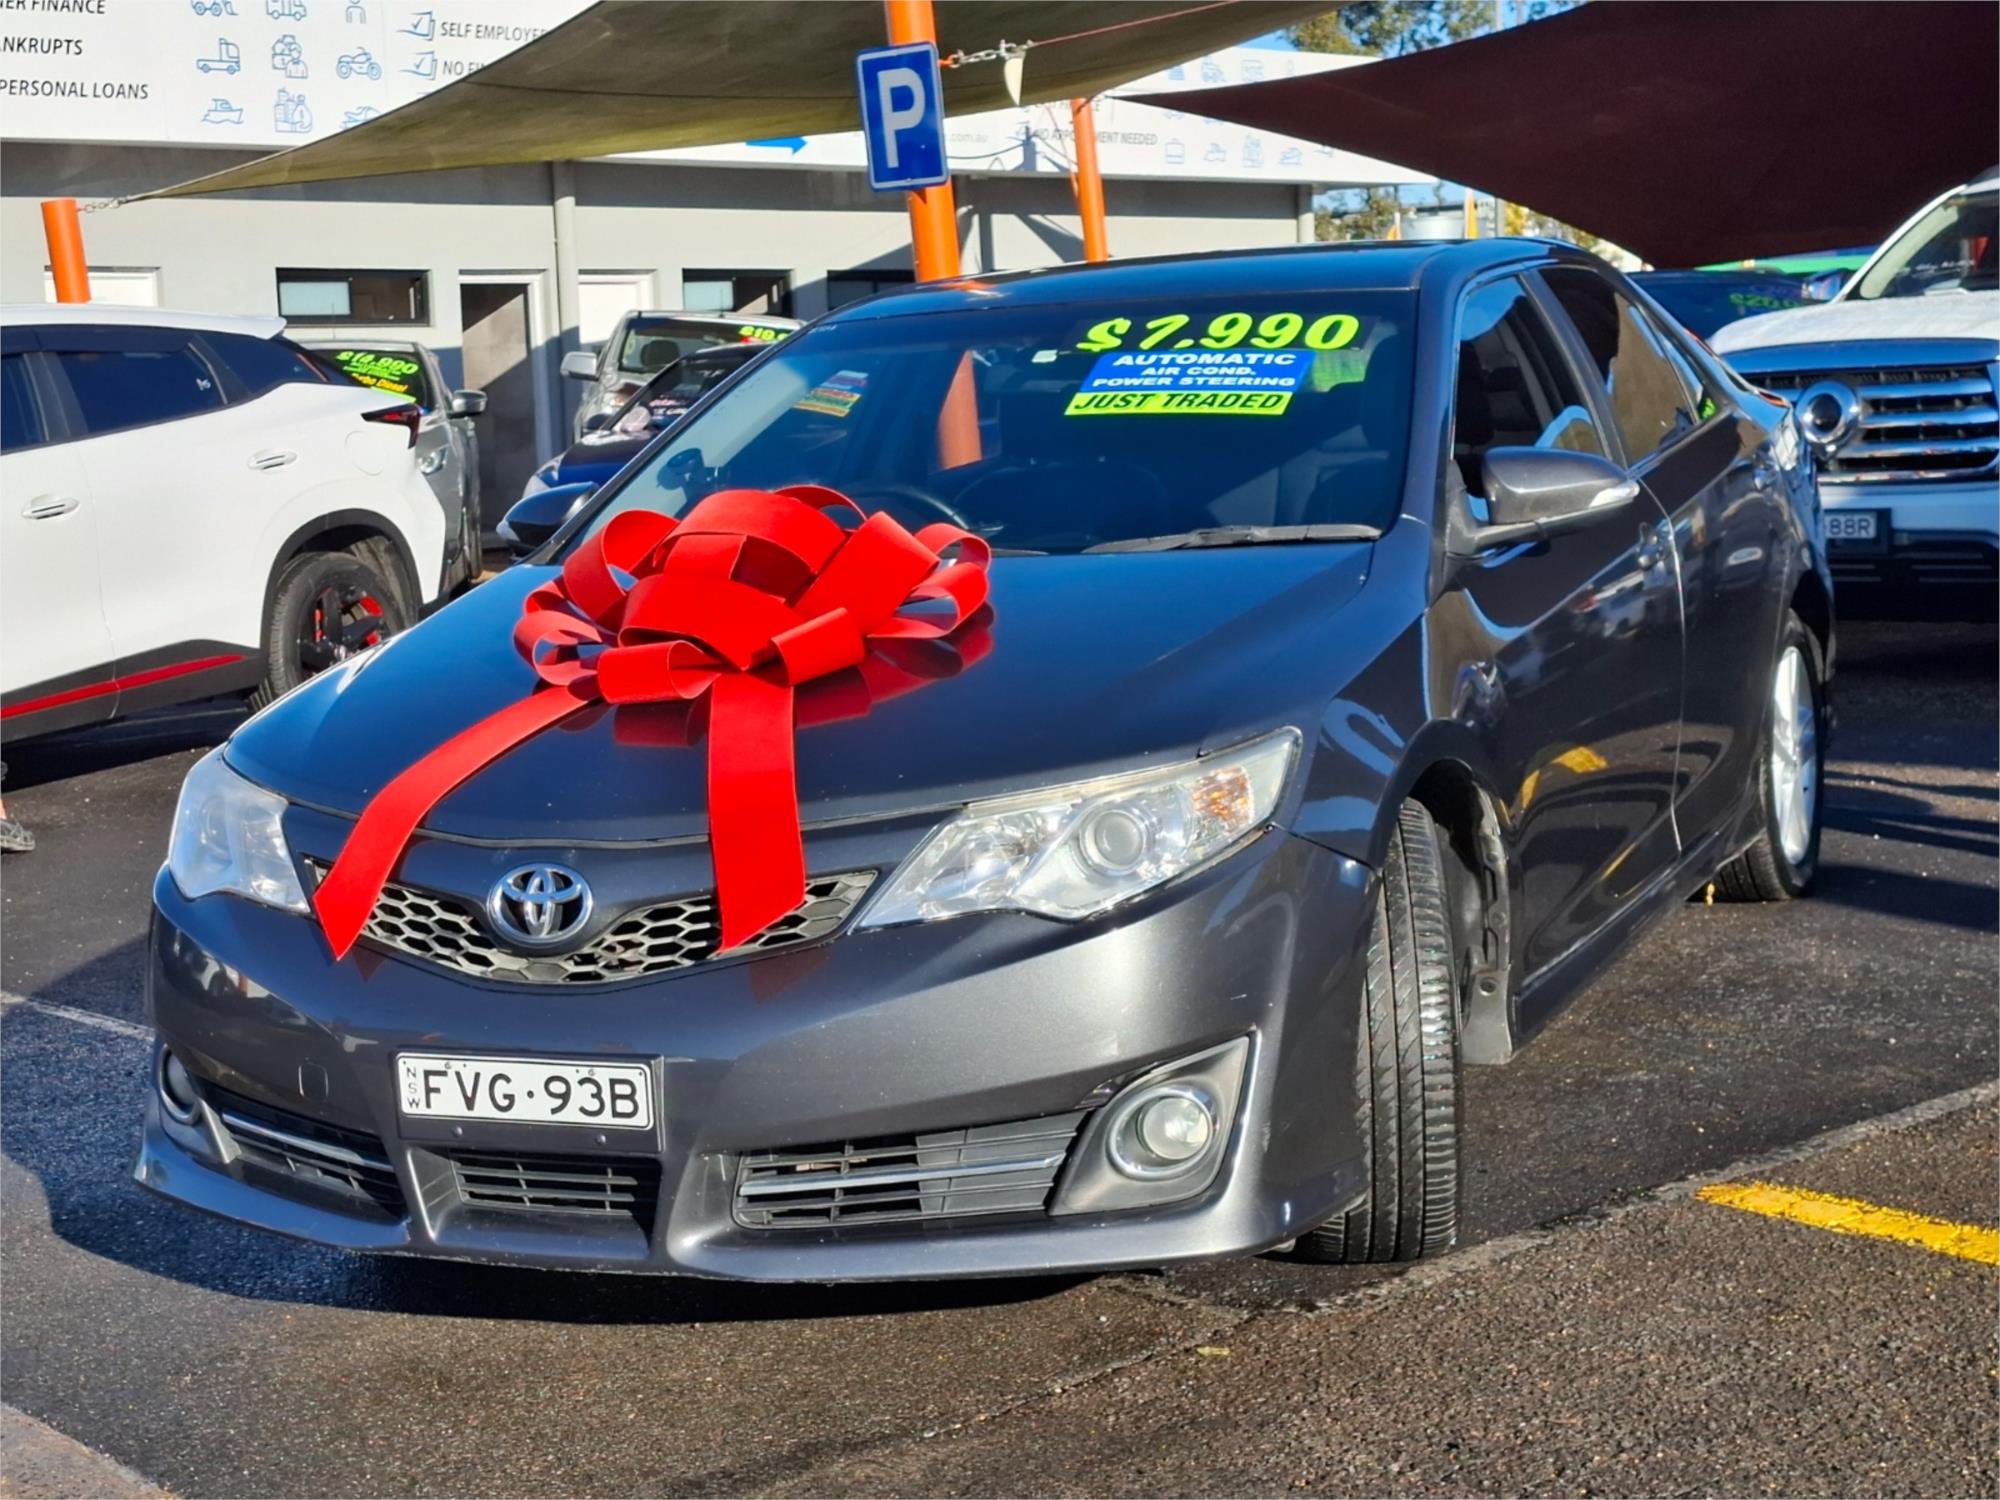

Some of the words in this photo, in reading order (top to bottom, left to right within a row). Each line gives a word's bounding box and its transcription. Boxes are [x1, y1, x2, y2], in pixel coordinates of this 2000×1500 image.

[441, 21, 472, 38] SELF
[0, 36, 83, 55] NKRUPTS
[443, 60, 464, 76] NO
[0, 79, 88, 97] PERSONAL
[93, 82, 149, 99] LOANS
[877, 67, 925, 168] P
[1120, 132, 1158, 145] NEEDED
[1112, 353, 1297, 366] AUTOMATIC
[1140, 367, 1181, 376] AIR
[1186, 367, 1257, 376] COND.
[1092, 377, 1174, 387] POWER
[1178, 377, 1297, 387] STEERING
[1073, 393, 1159, 410] JUST
[1163, 393, 1285, 410] TRADED
